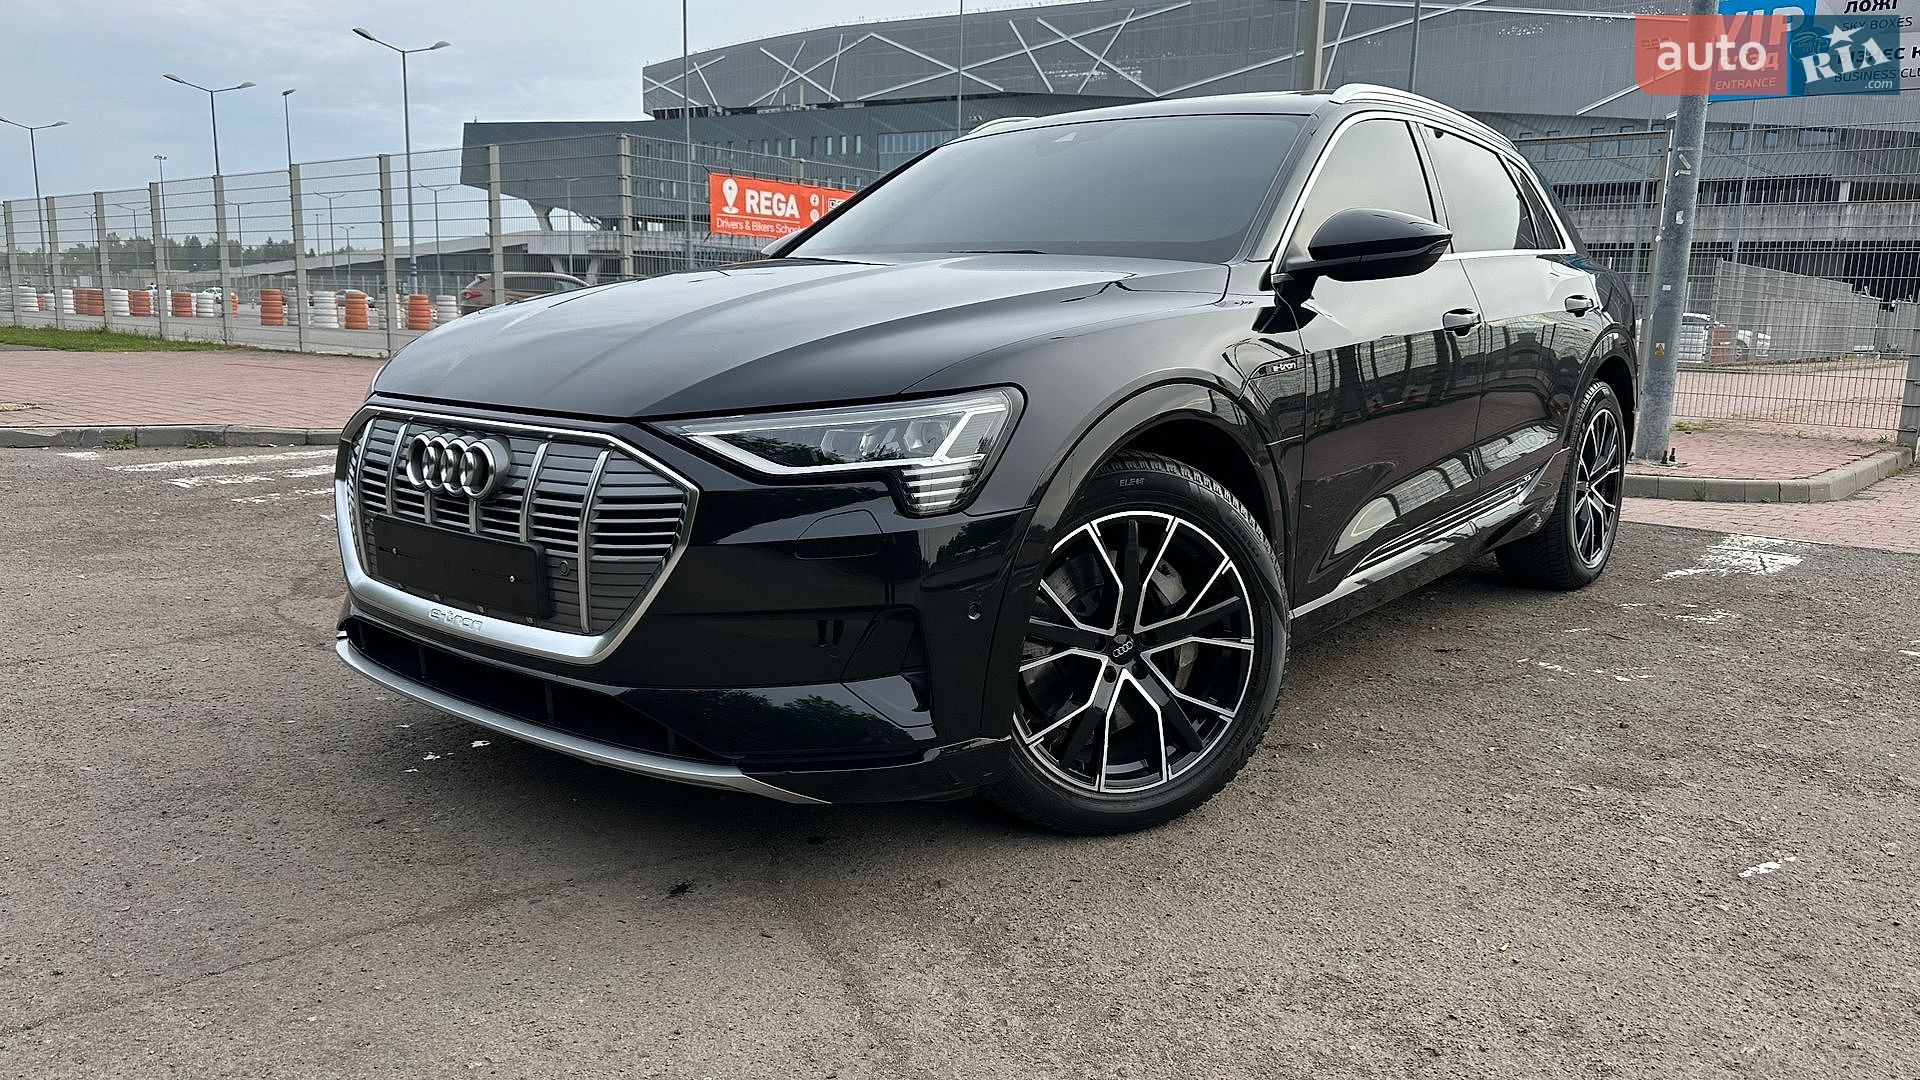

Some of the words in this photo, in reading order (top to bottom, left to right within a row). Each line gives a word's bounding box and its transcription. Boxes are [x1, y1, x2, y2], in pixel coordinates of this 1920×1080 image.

[1714, 7, 1805, 46] VIP
[1842, 20, 1867, 32] SKY
[1870, 16, 1913, 30] BOXES
[1836, 47, 1905, 64] ІЗЕС
[1715, 77, 1776, 90] ENTRANCE
[1834, 69, 1897, 83] BUSINESS
[745, 189, 800, 218] REGA
[716, 217, 744, 230] Drivers
[744, 220, 751, 231] &
[751, 221, 775, 233] Bikers
[1273, 361, 1296, 372] e-tron
